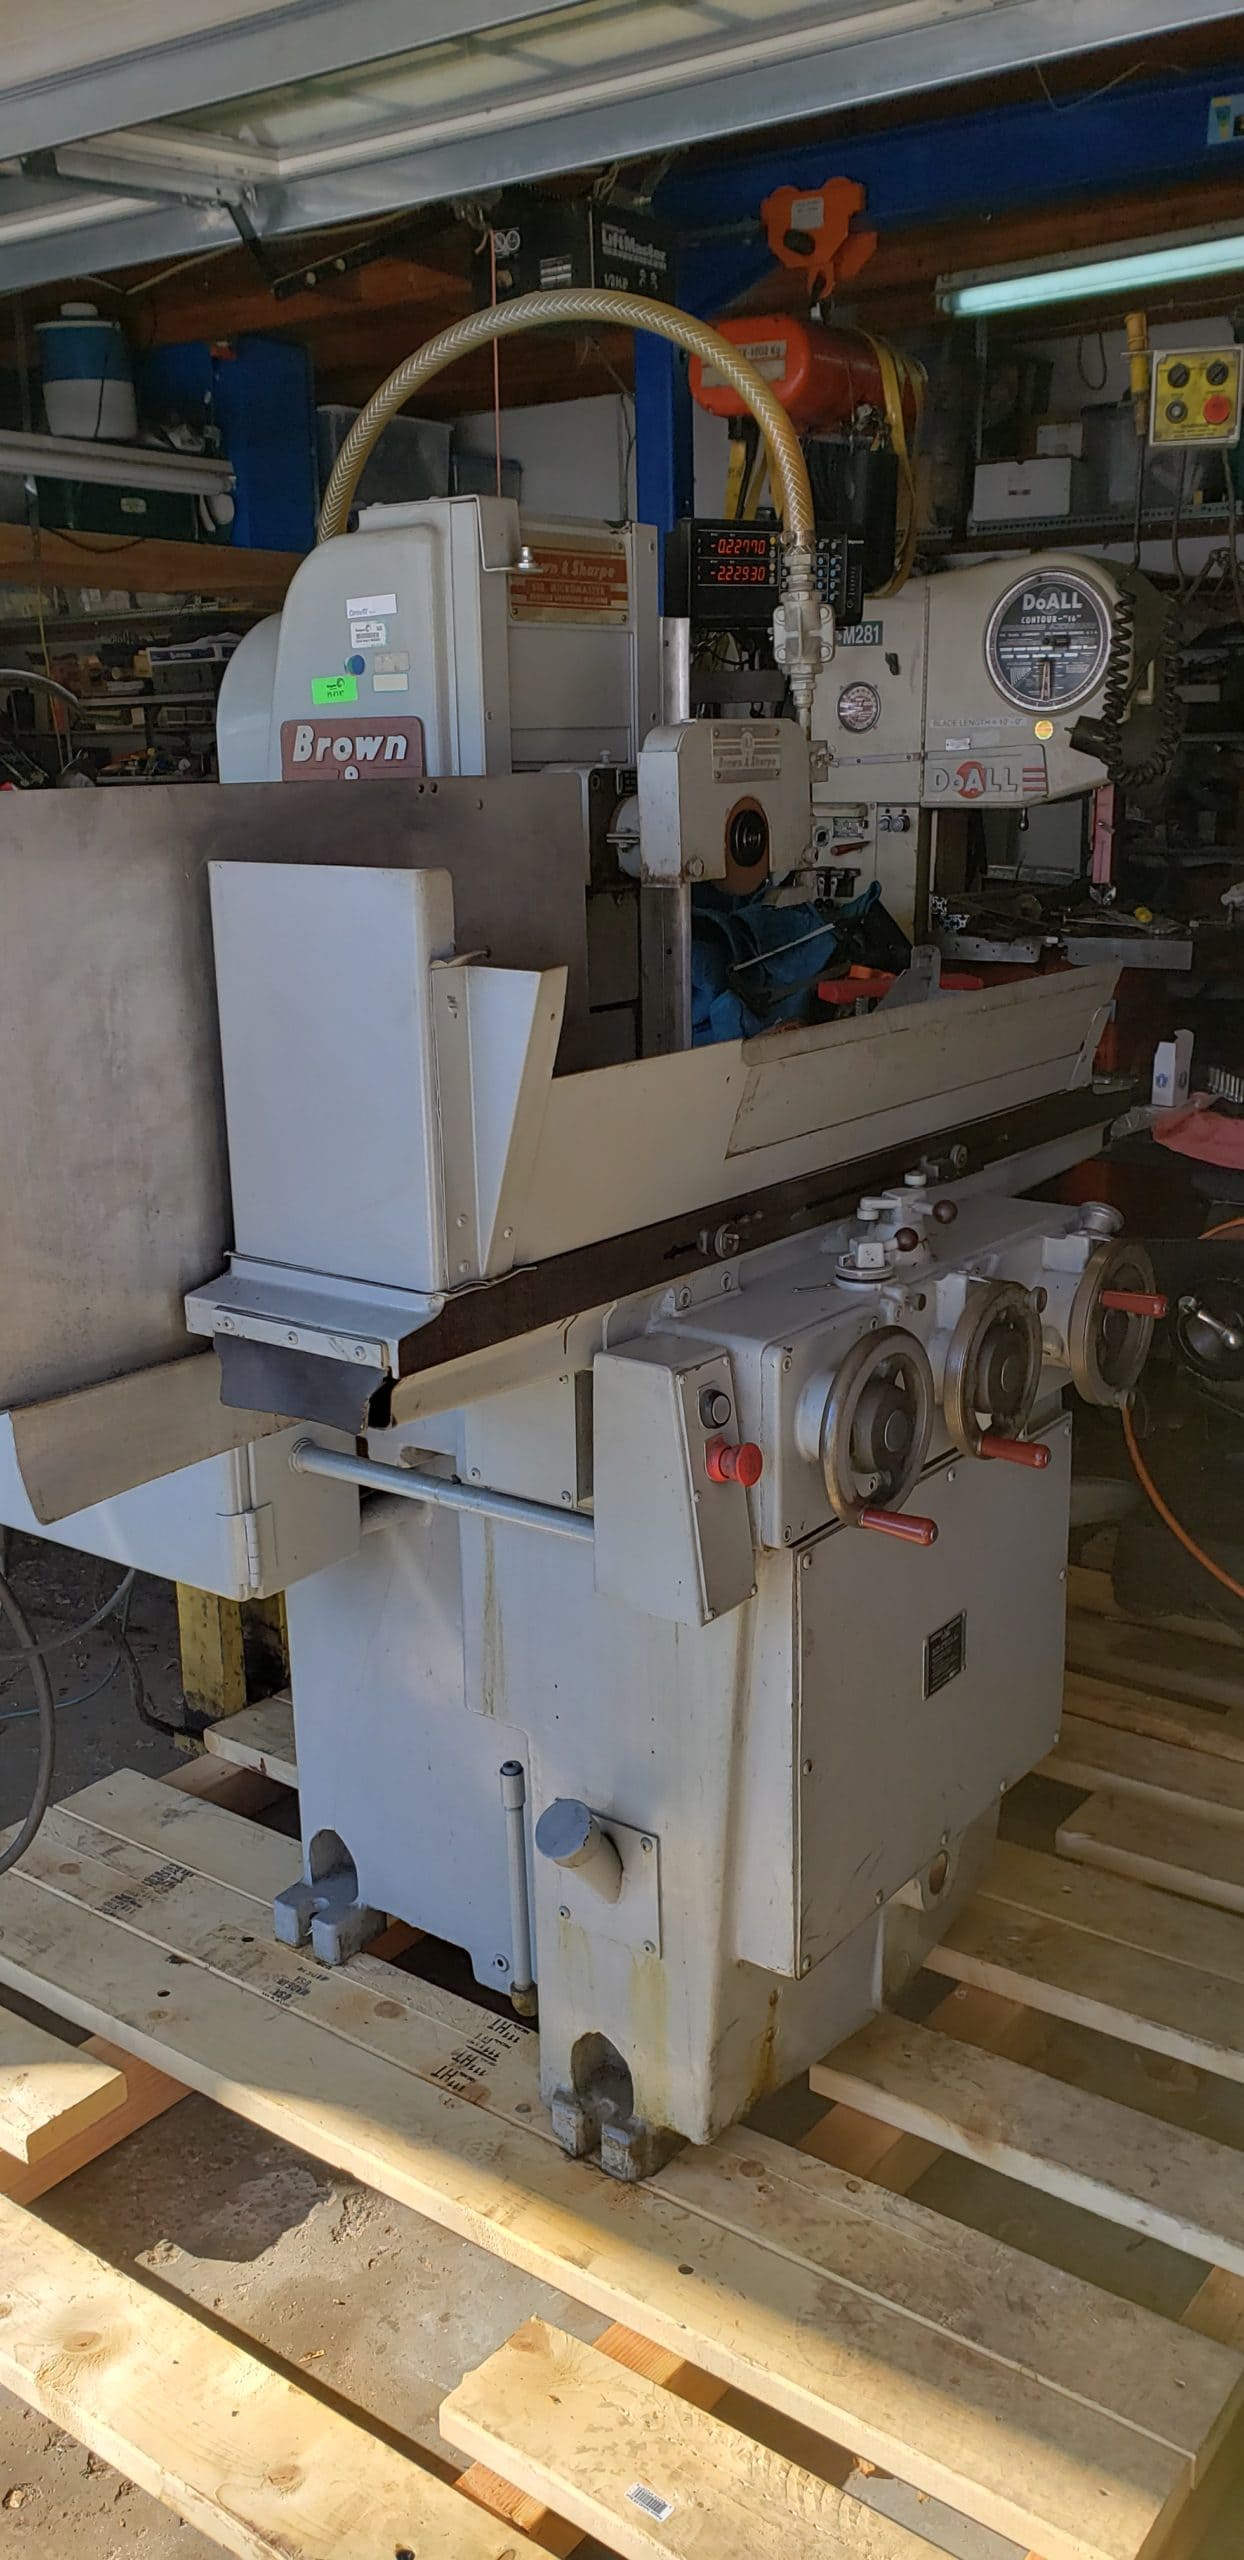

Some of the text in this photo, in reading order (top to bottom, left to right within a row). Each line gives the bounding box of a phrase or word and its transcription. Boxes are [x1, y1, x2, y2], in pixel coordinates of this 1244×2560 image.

[571, 560, 616, 580] Sharpe
[1022, 591, 1083, 611] DoALL
[843, 624, 879, 645] M281
[292, 725, 407, 762] Brown
[929, 767, 1018, 793] DoALL
